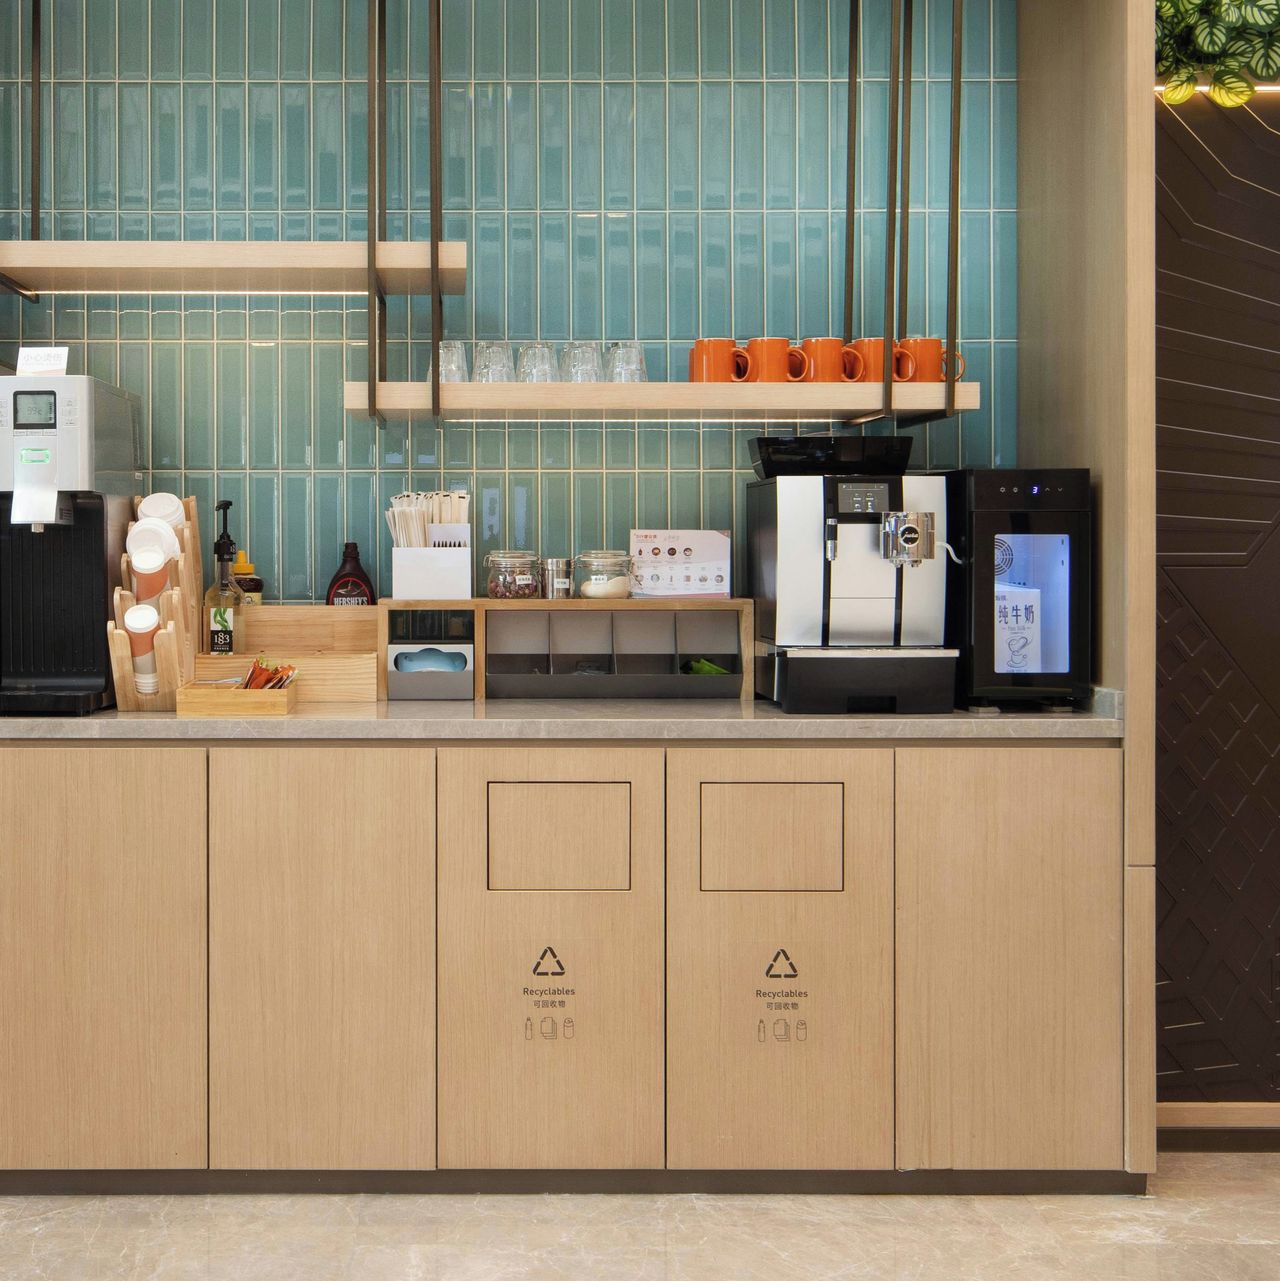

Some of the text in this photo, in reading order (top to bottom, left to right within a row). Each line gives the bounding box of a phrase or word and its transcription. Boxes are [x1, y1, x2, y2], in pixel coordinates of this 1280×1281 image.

[998, 604, 1035, 625] 纯牛奶
[523, 987, 576, 998] Recyclables
[755, 989, 809, 1000] Recyclables
[533, 999, 566, 1009] 可回收物
[766, 1001, 800, 1011] 可回收物
